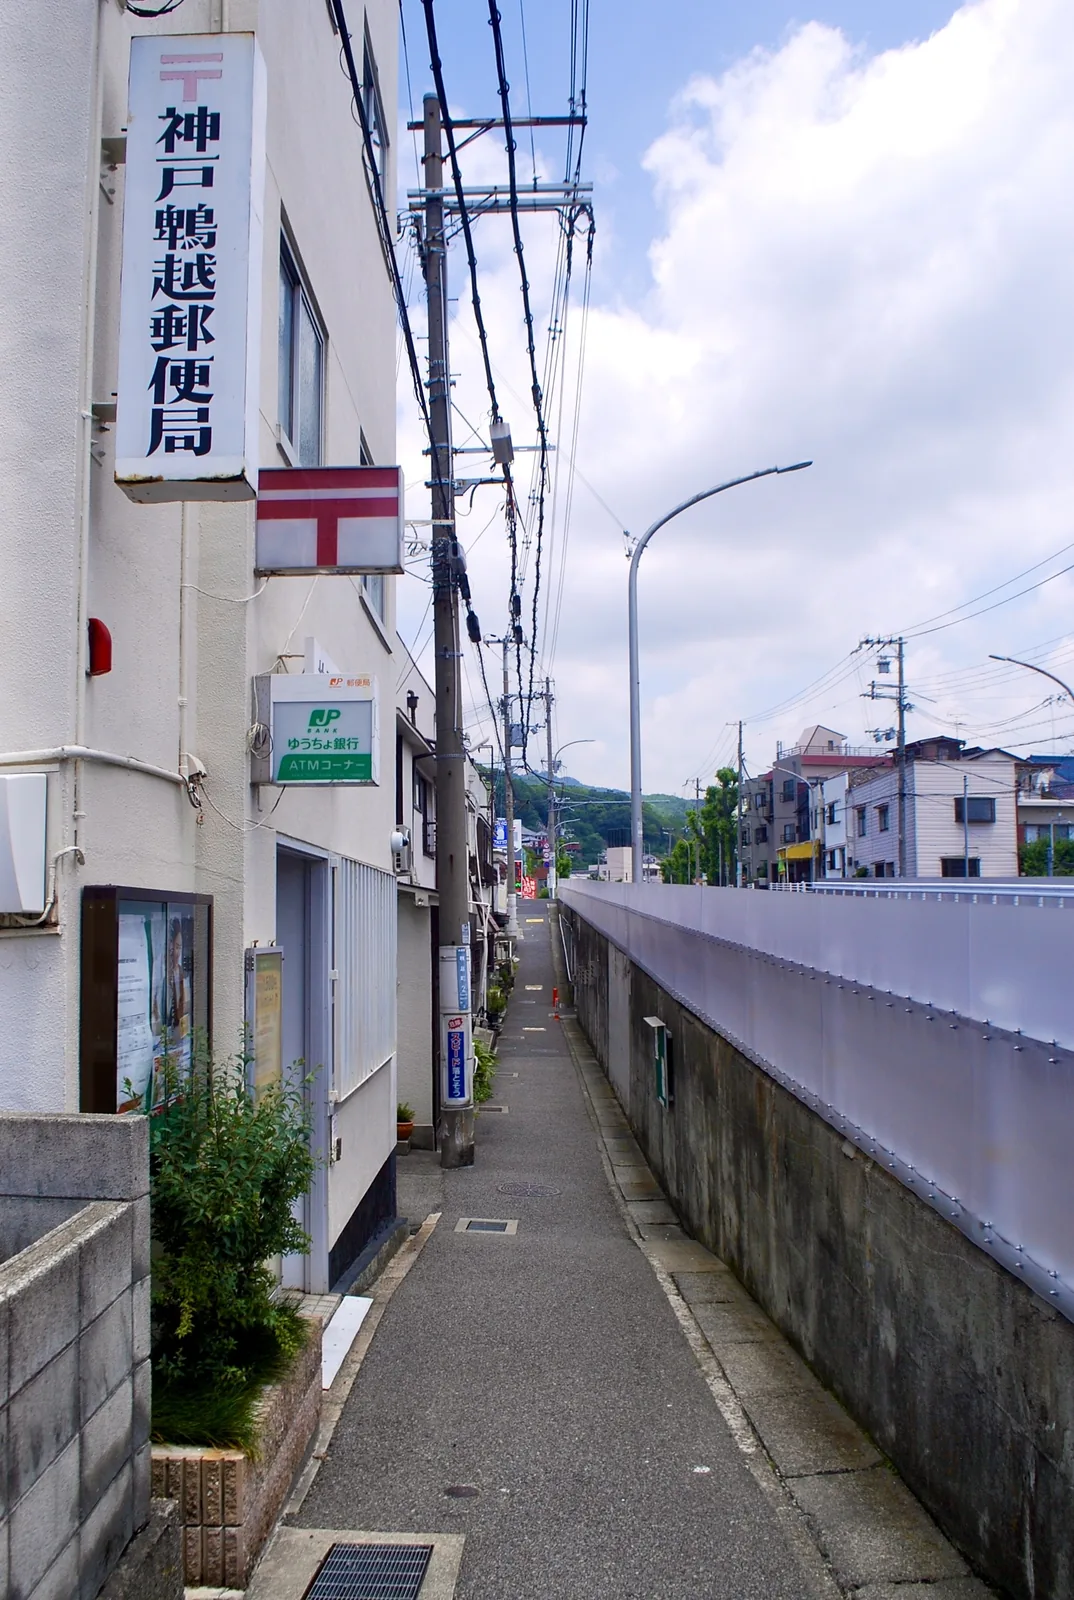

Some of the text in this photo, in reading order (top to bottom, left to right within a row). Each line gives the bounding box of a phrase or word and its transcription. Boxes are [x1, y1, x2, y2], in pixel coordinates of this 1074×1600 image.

[147, 105, 220, 458] 神戸鵯越郵便局
[346, 678, 371, 687] 郵便局
[308, 709, 341, 727] JP
[288, 737, 359, 750] ゆうちょ銀行
[289, 760, 365, 771] ATMコーナー
